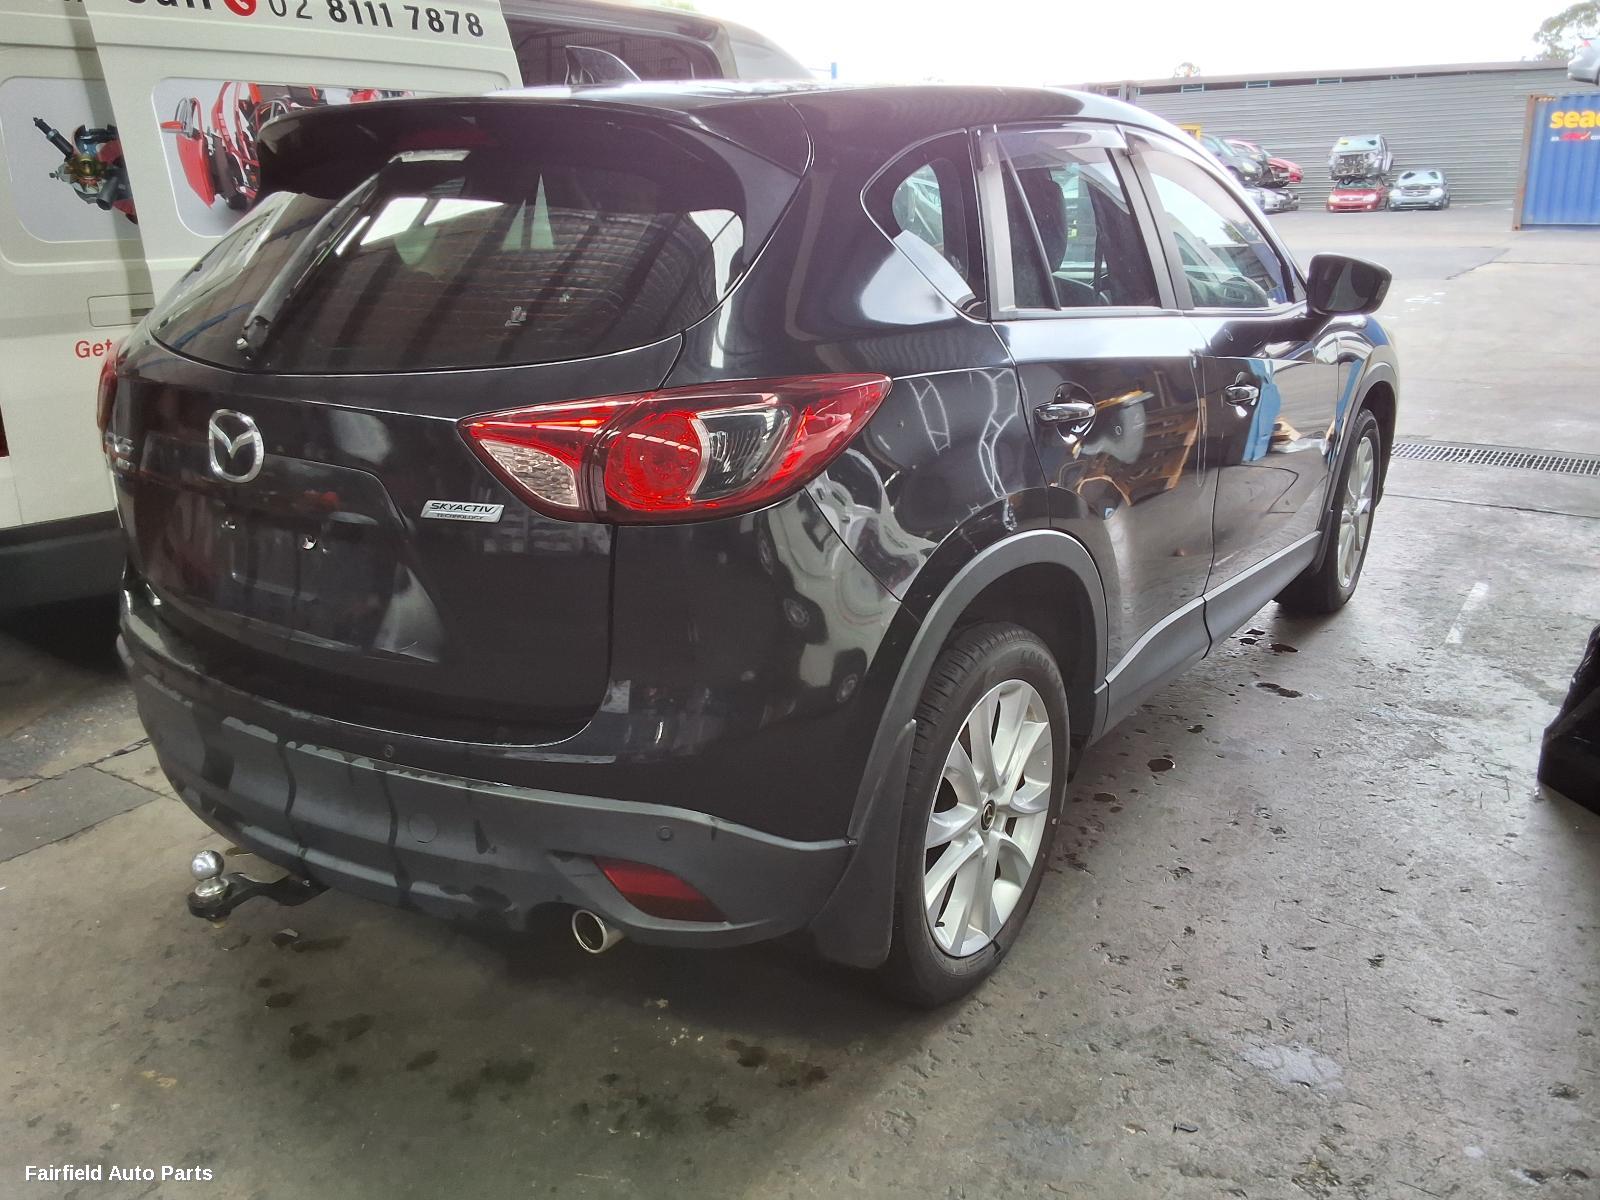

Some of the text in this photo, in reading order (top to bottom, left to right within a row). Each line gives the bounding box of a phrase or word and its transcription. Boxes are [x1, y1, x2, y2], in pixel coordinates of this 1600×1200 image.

[268, 0, 484, 37] 02 8111 7878
[430, 502, 494, 513] SKYACTIV
